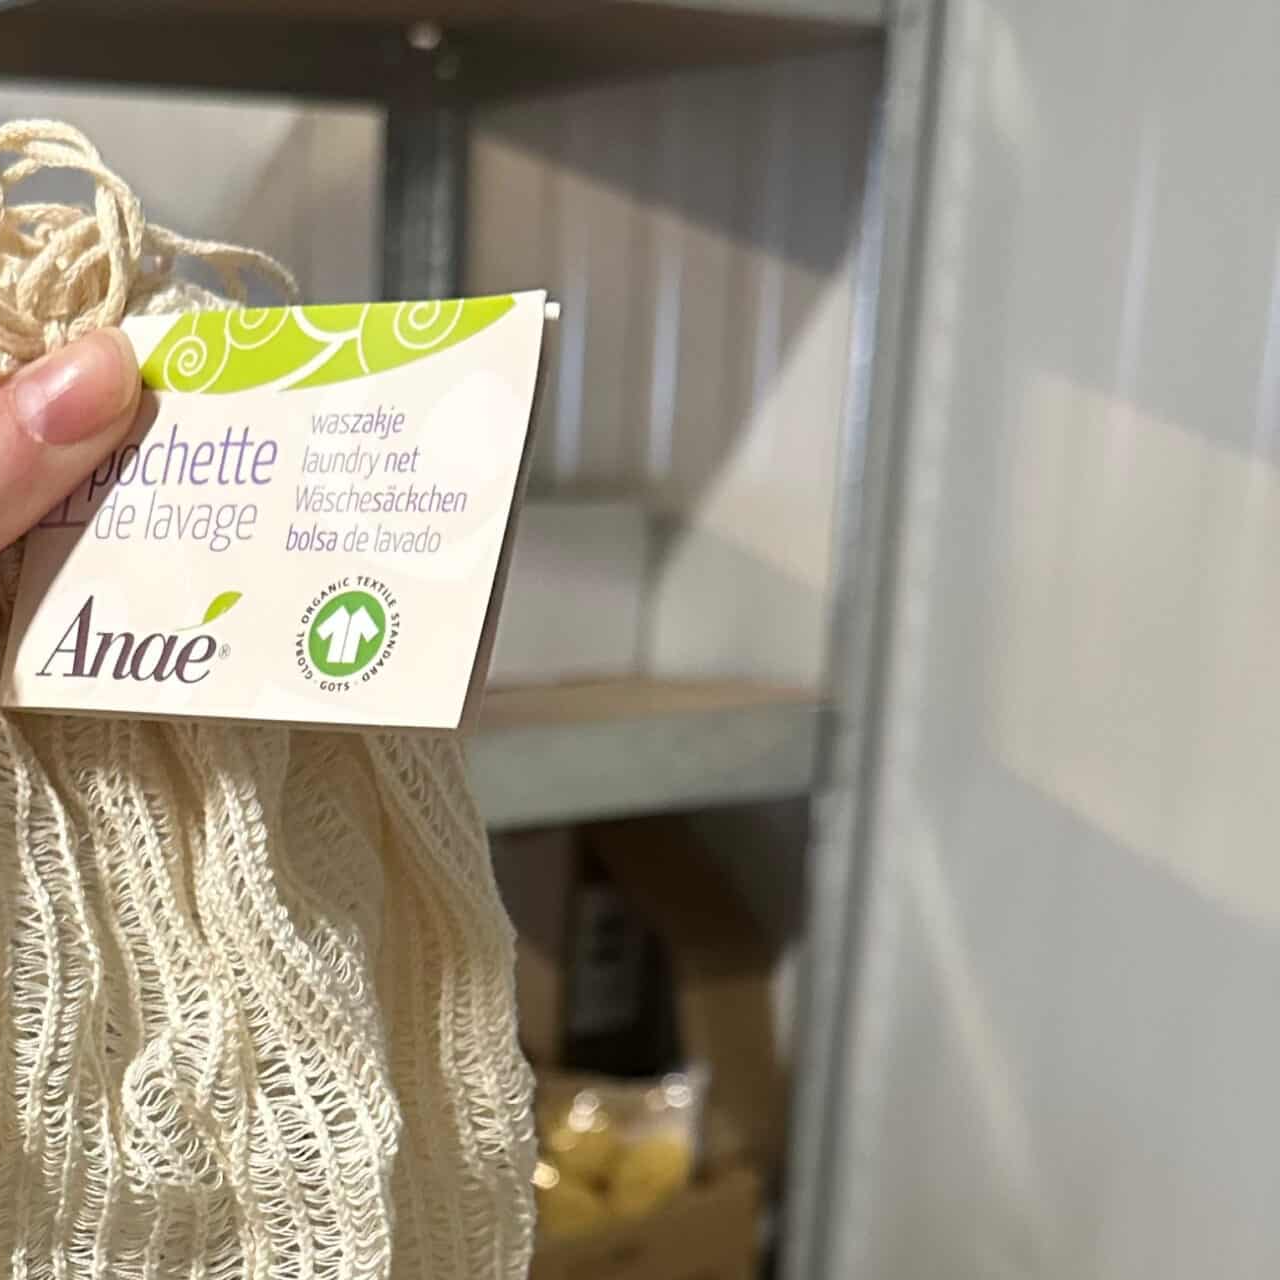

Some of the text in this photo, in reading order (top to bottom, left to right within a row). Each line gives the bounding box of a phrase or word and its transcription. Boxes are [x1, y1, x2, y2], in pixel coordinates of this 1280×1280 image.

[311, 404, 406, 440] waszakje
[87, 423, 278, 502] pochette
[302, 445, 421, 480] laundry net
[295, 483, 468, 513] Wäschesäckchen
[95, 490, 136, 540] de
[144, 490, 258, 552] lavage
[285, 522, 442, 553] bolsa de lavado
[295, 575, 400, 682] GLOBAL ORGANIC TEXTILE STANDARD
[319, 680, 350, 692] GOTS
